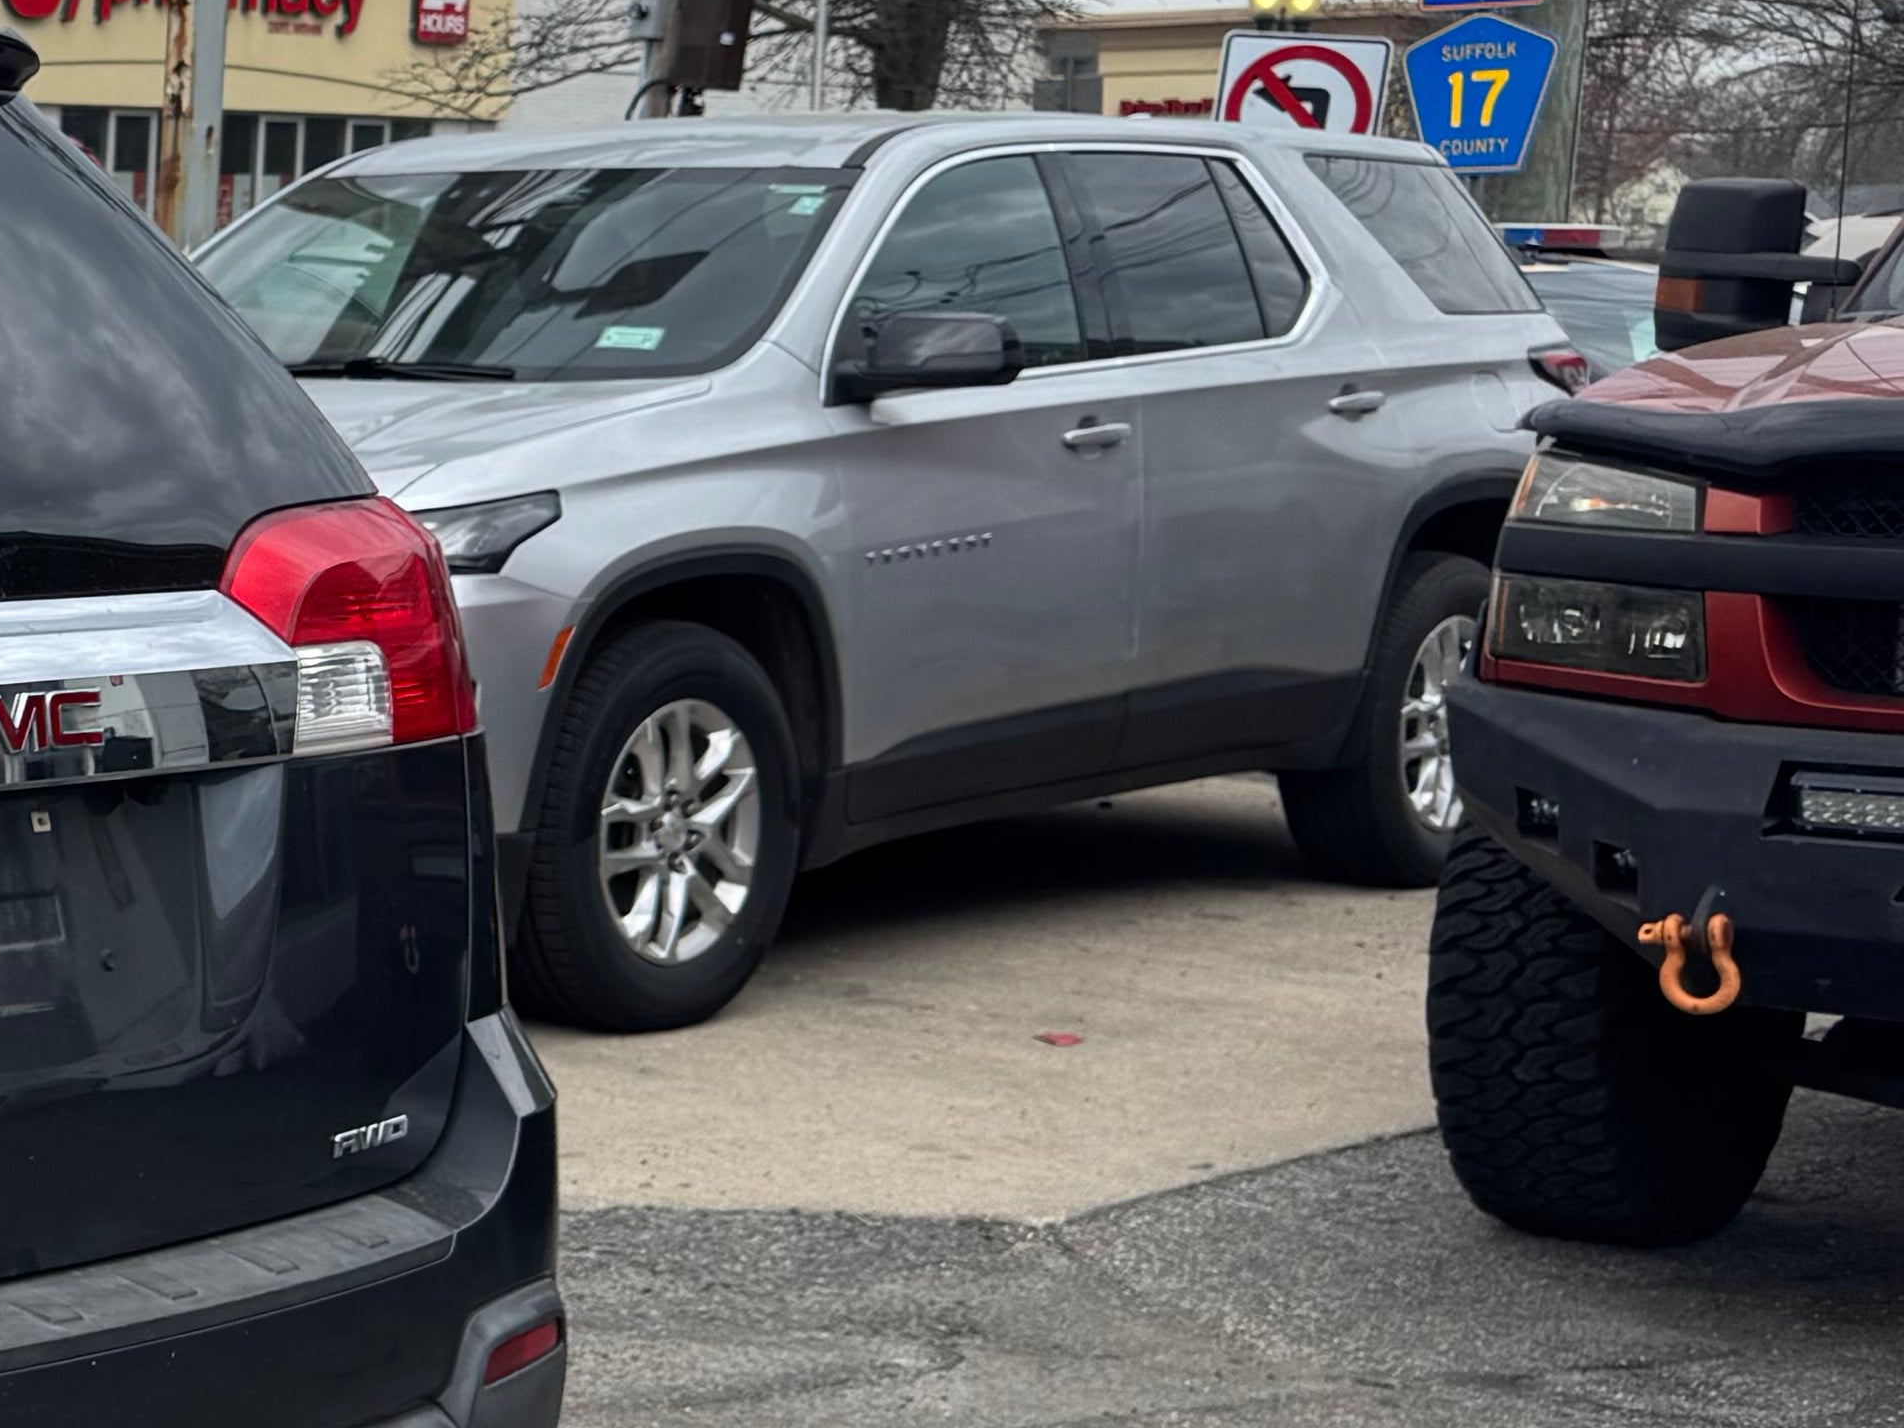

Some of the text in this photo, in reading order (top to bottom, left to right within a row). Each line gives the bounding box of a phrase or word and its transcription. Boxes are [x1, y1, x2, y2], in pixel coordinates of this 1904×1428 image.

[419, 13, 465, 35] HOURS
[1441, 41, 1516, 62] SUFFOLK
[1447, 69, 1510, 128] 17
[1440, 137, 1509, 156] COUNTY
[333, 1114, 409, 1159] AWD
